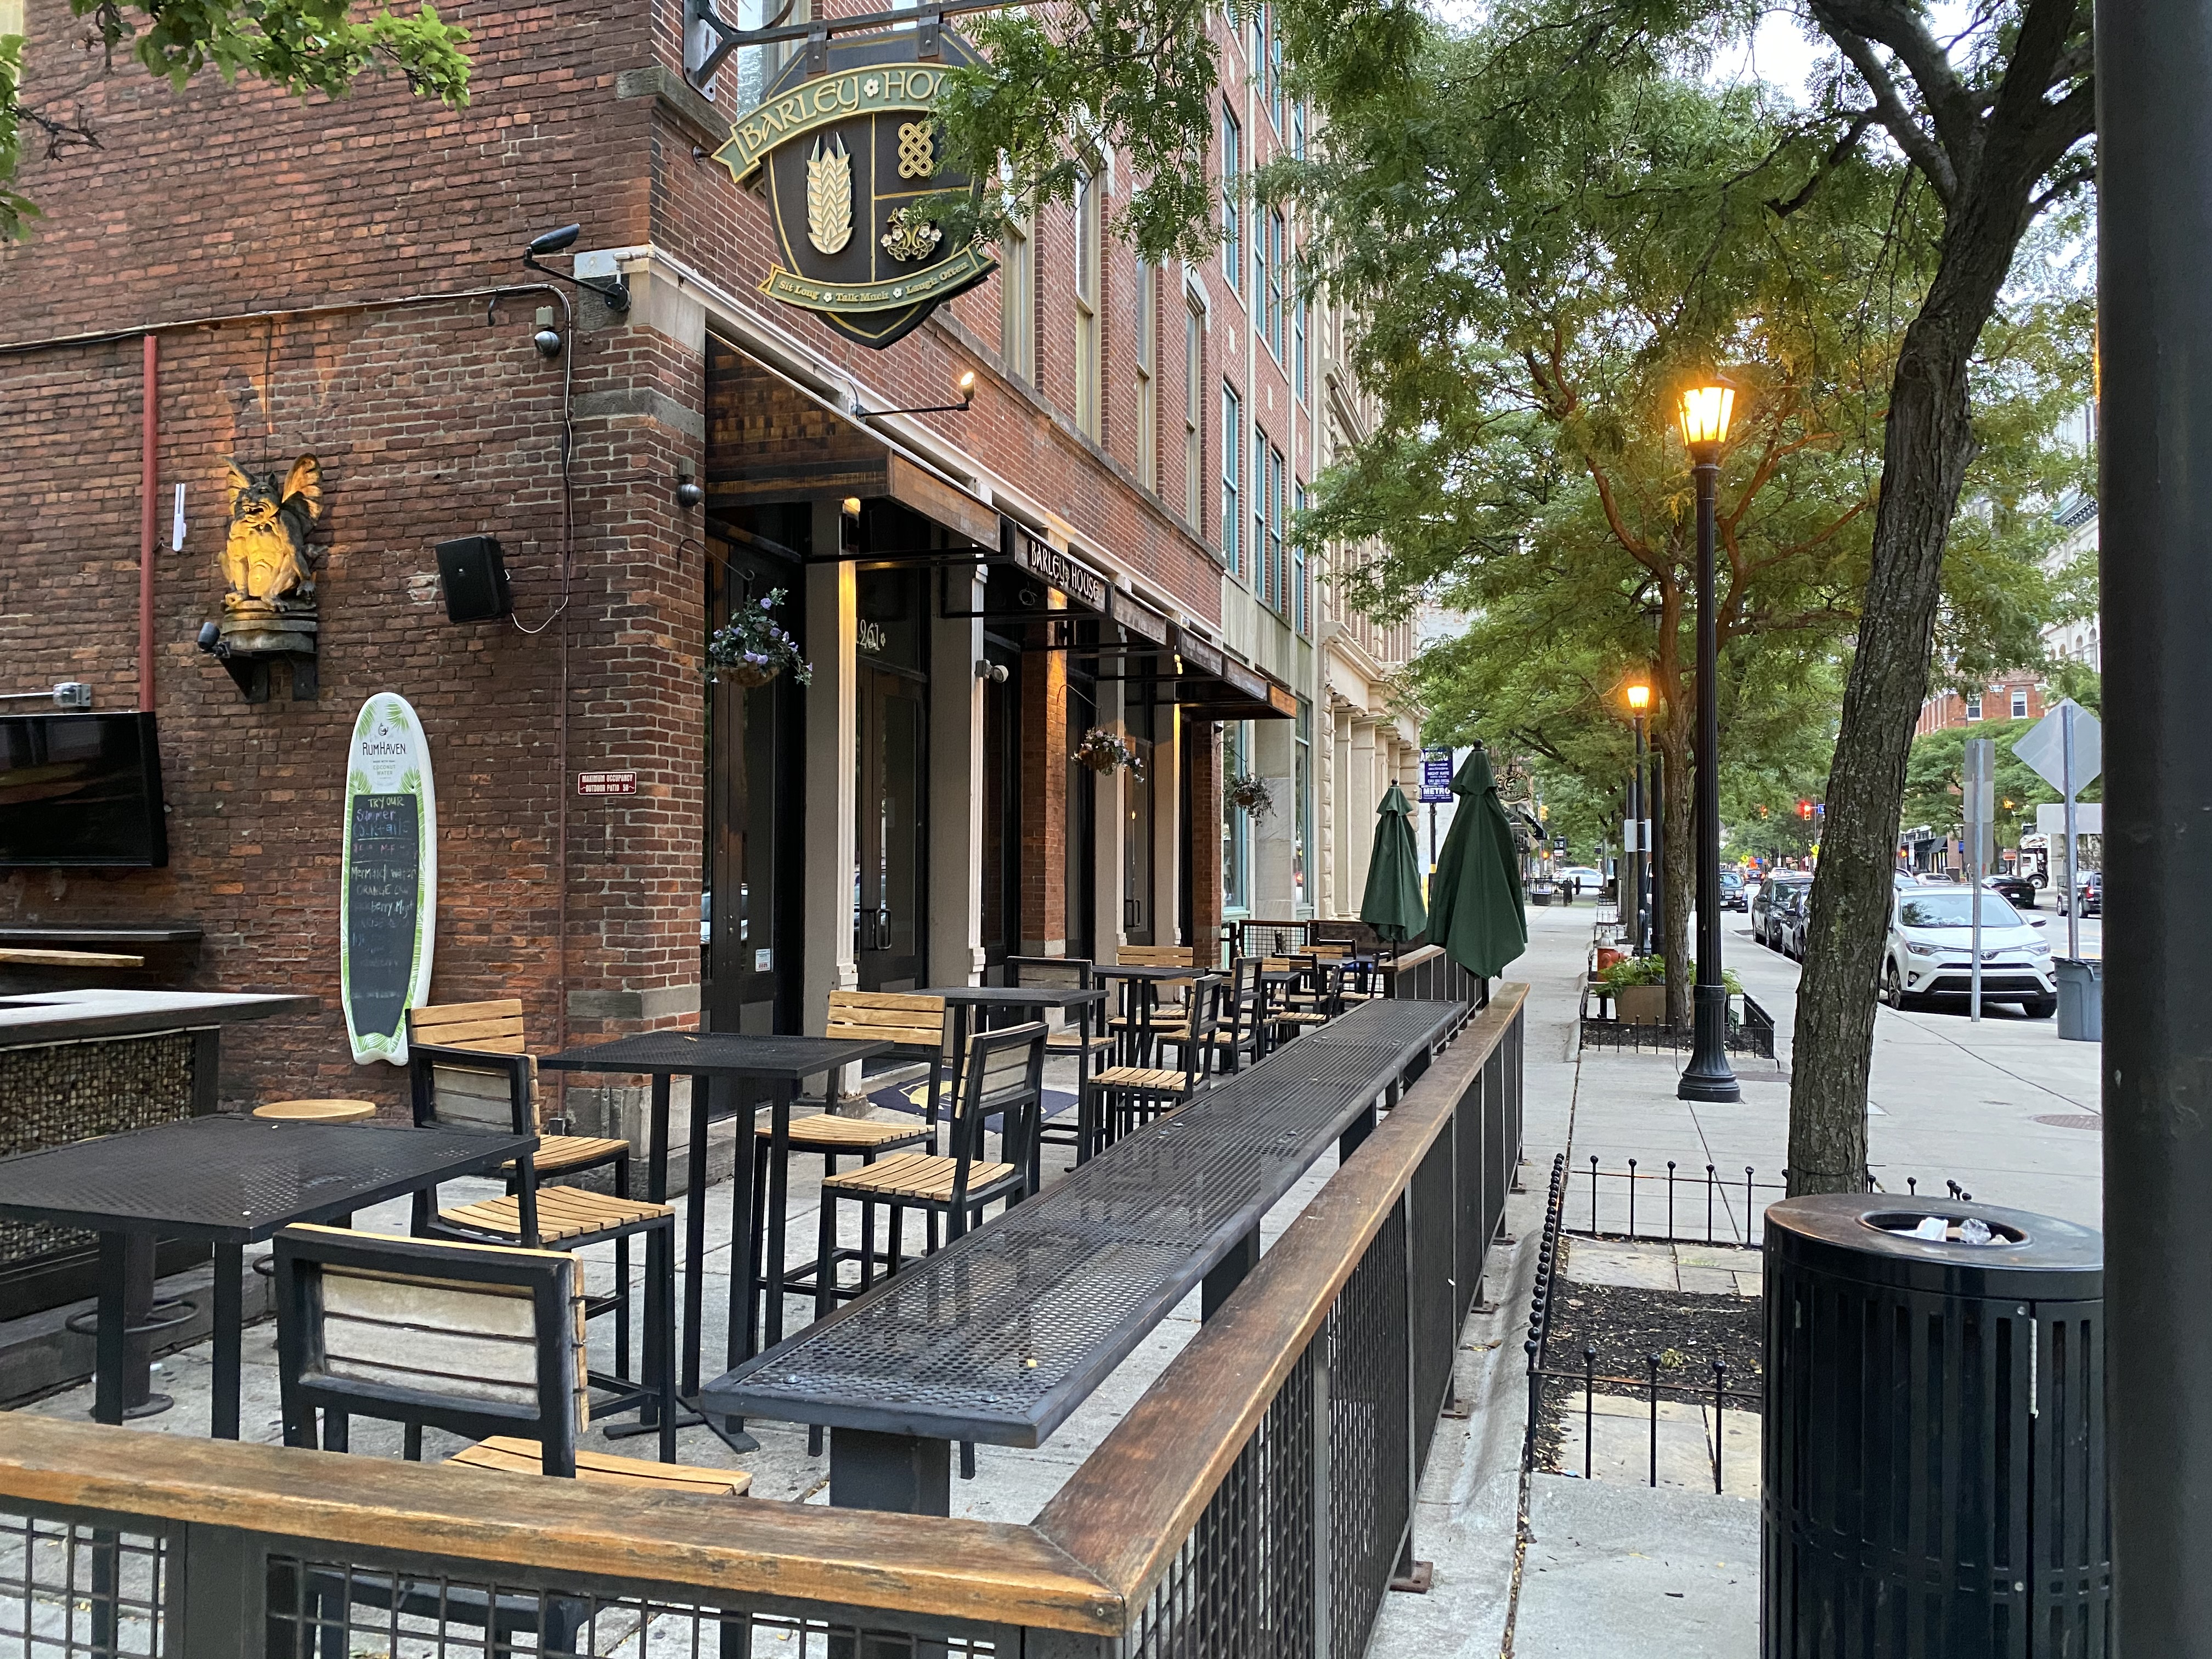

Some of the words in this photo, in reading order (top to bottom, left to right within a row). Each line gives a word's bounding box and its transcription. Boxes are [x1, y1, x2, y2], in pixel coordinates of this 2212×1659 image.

[739, 76, 861, 151] BARLEY
[778, 280, 793, 291] Sit
[795, 285, 820, 300] Long
[836, 292, 859, 302] Talk
[860, 291, 889, 302] Much
[906, 277, 939, 294] Laugh
[939, 262, 969, 281] Often
[1031, 540, 1064, 586] BARLEY
[1071, 564, 1098, 601] HOUSE
[368, 797, 384, 809] TRY
[386, 796, 405, 806] OUR
